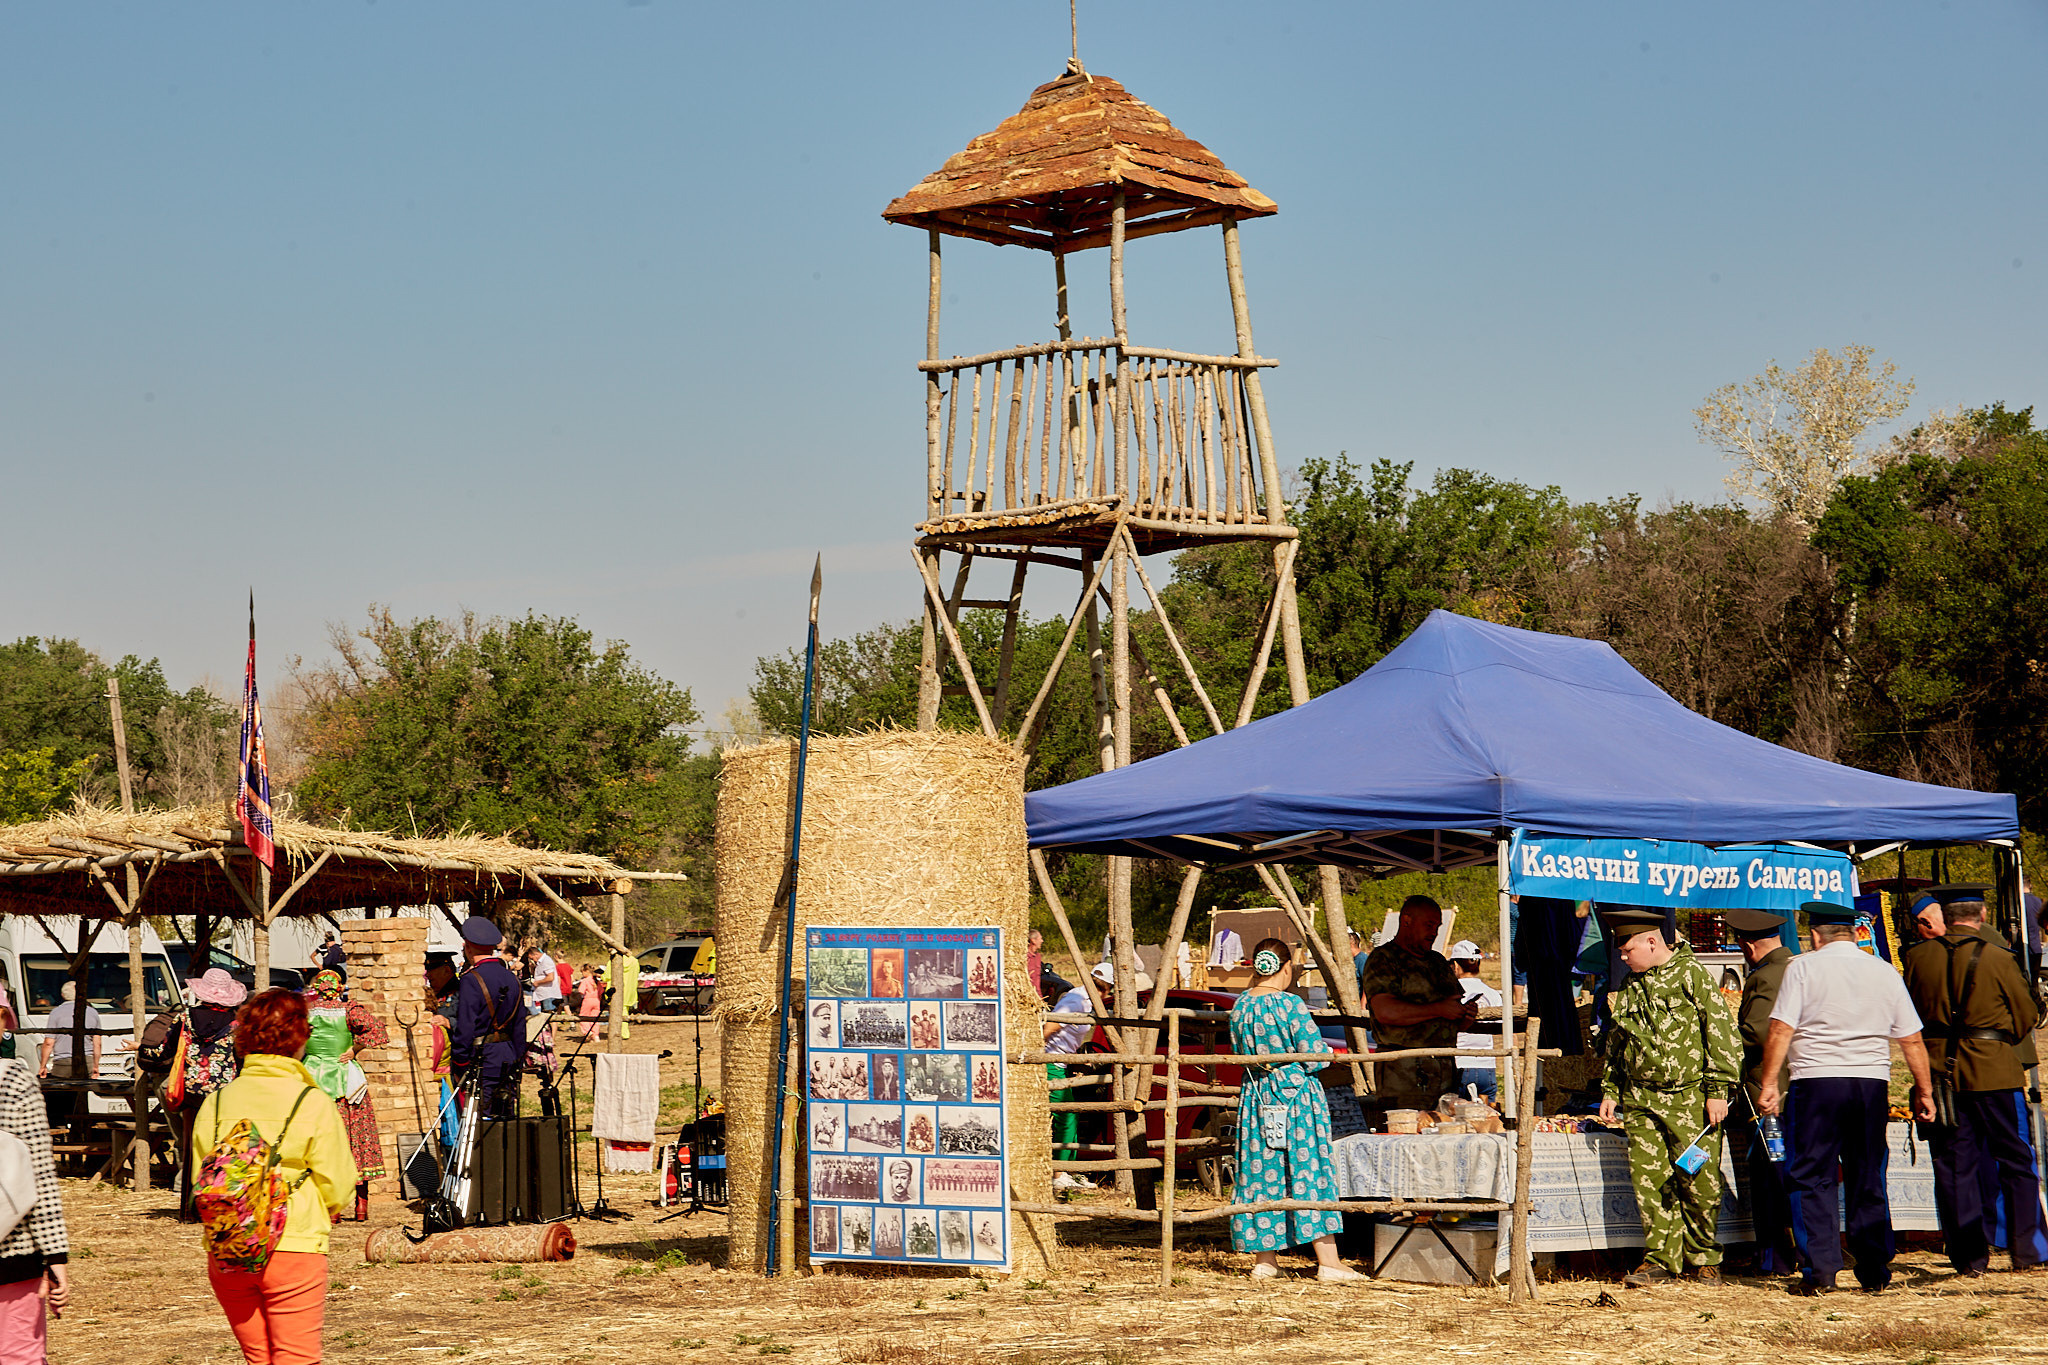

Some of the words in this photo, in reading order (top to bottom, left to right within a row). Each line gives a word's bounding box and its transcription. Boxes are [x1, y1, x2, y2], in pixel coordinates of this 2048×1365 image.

[1521, 844, 1640, 884] Казачий
[1648, 862, 1740, 897] курень
[1747, 858, 1844, 899] Самара
